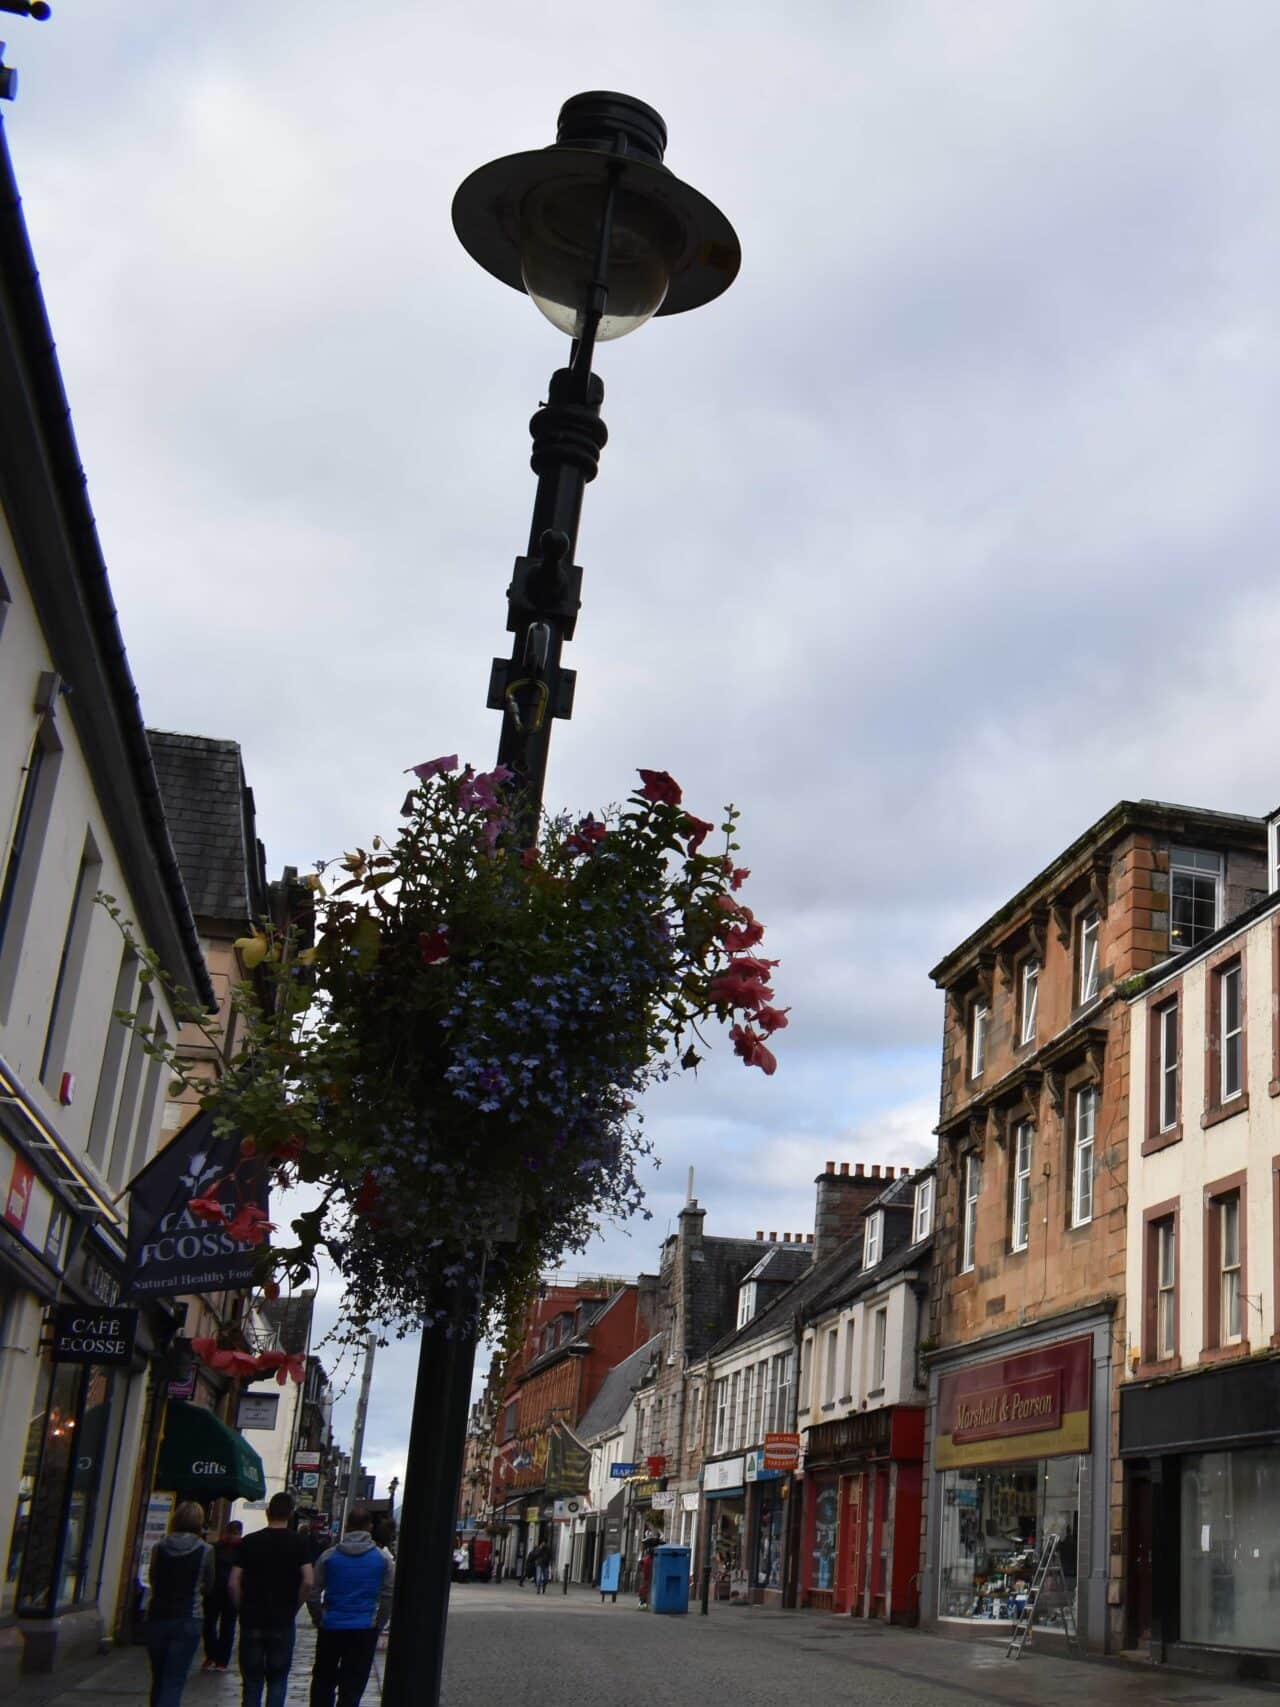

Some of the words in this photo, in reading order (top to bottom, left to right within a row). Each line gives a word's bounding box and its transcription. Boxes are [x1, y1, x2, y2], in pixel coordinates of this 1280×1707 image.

[133, 1277, 178, 1290] Natural
[182, 1271, 225, 1286] Healthy
[61, 1337, 127, 1354] ECOSSE
[957, 1398, 998, 1430] Marshall
[999, 1393, 1009, 1423] &
[1011, 1392, 1053, 1420] Pearson
[192, 1460, 227, 1475] Gifts
